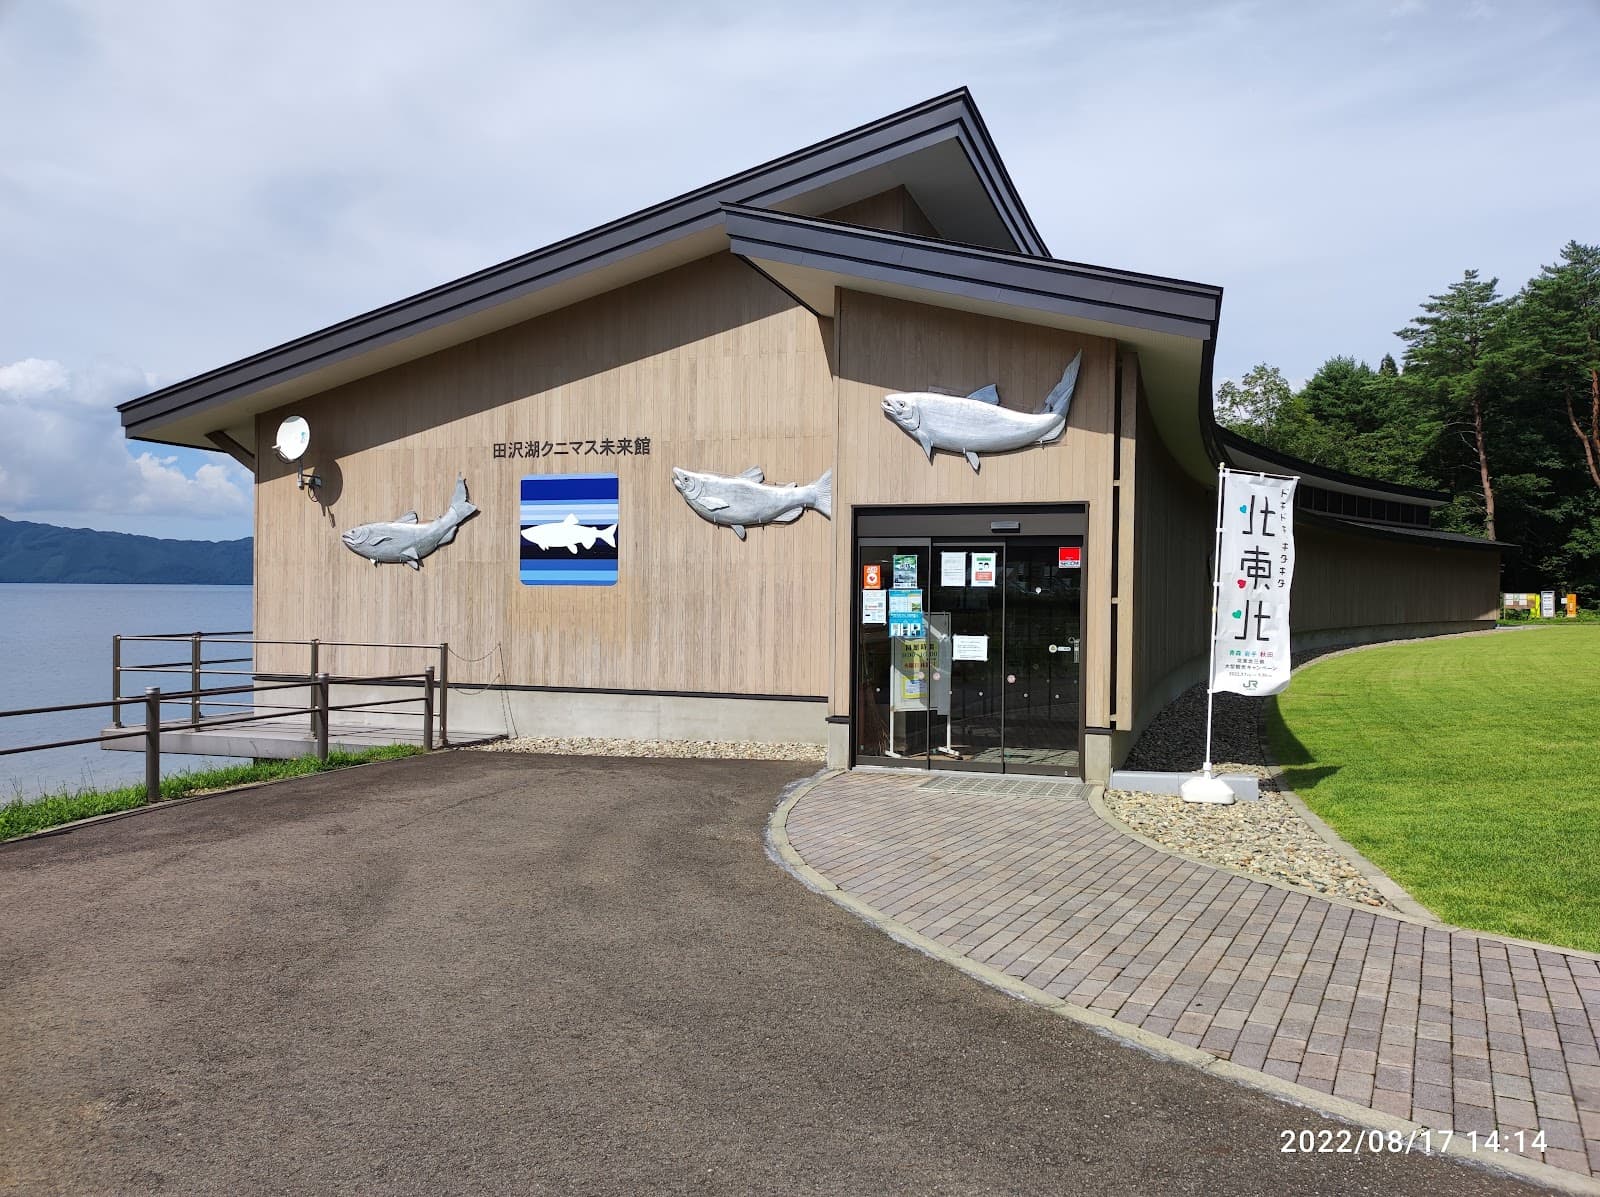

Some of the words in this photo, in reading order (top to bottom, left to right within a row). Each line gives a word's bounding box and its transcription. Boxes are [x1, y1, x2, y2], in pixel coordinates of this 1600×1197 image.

[493, 437, 651, 459] 田沢湖クニマス未来館
[1234, 495, 1276, 642] 北東北
[1243, 680, 1258, 688] JR
